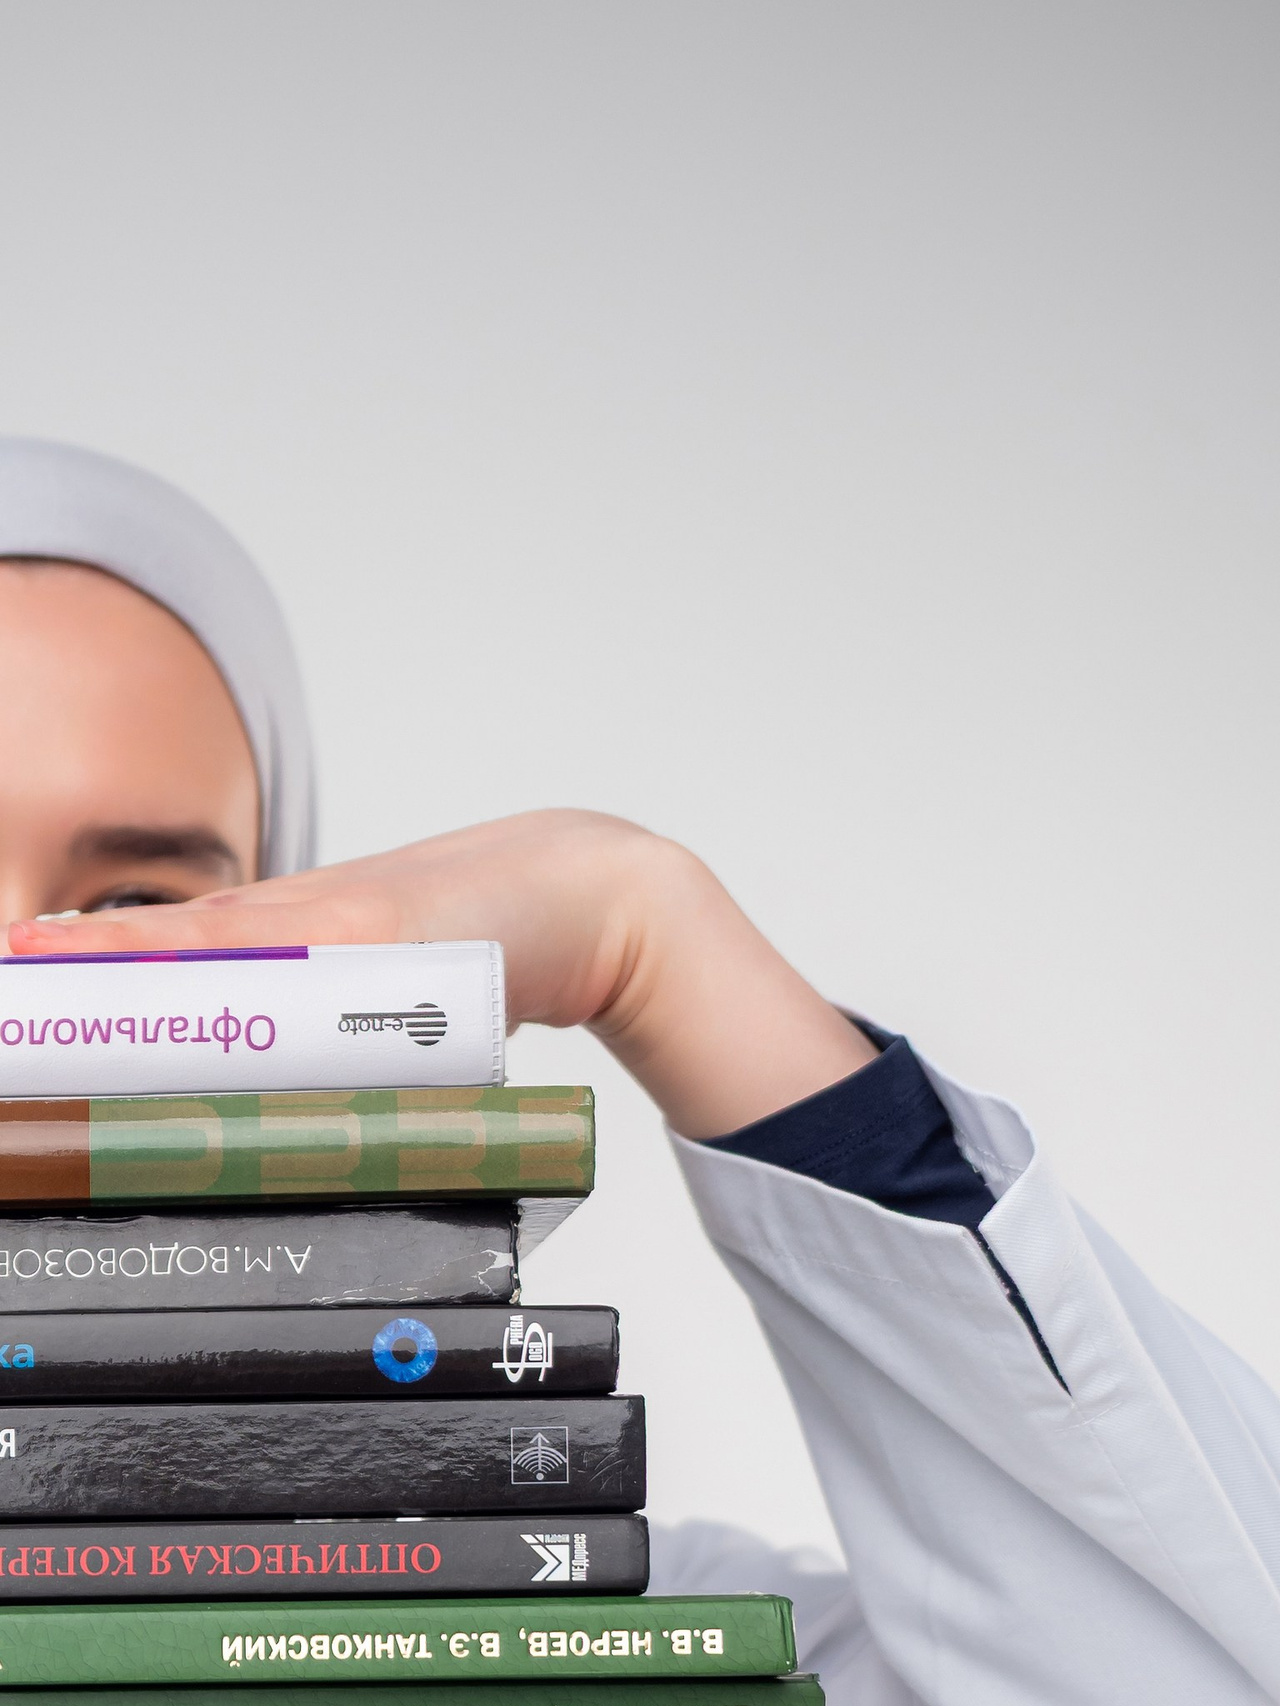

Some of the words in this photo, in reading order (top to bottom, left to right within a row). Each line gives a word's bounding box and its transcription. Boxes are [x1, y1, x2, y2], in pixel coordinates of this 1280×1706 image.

[337, 1018, 404, 1036] e-noto
[149, 1543, 442, 1576] ОПТИЧЕСКАЯ
[223, 1634, 433, 1667] ТАНКОВСКИЙ
[441, 1633, 501, 1658] В.Э.
[519, 1628, 652, 1657] НЕРОЕВ,
[663, 1629, 724, 1655] В.В.
